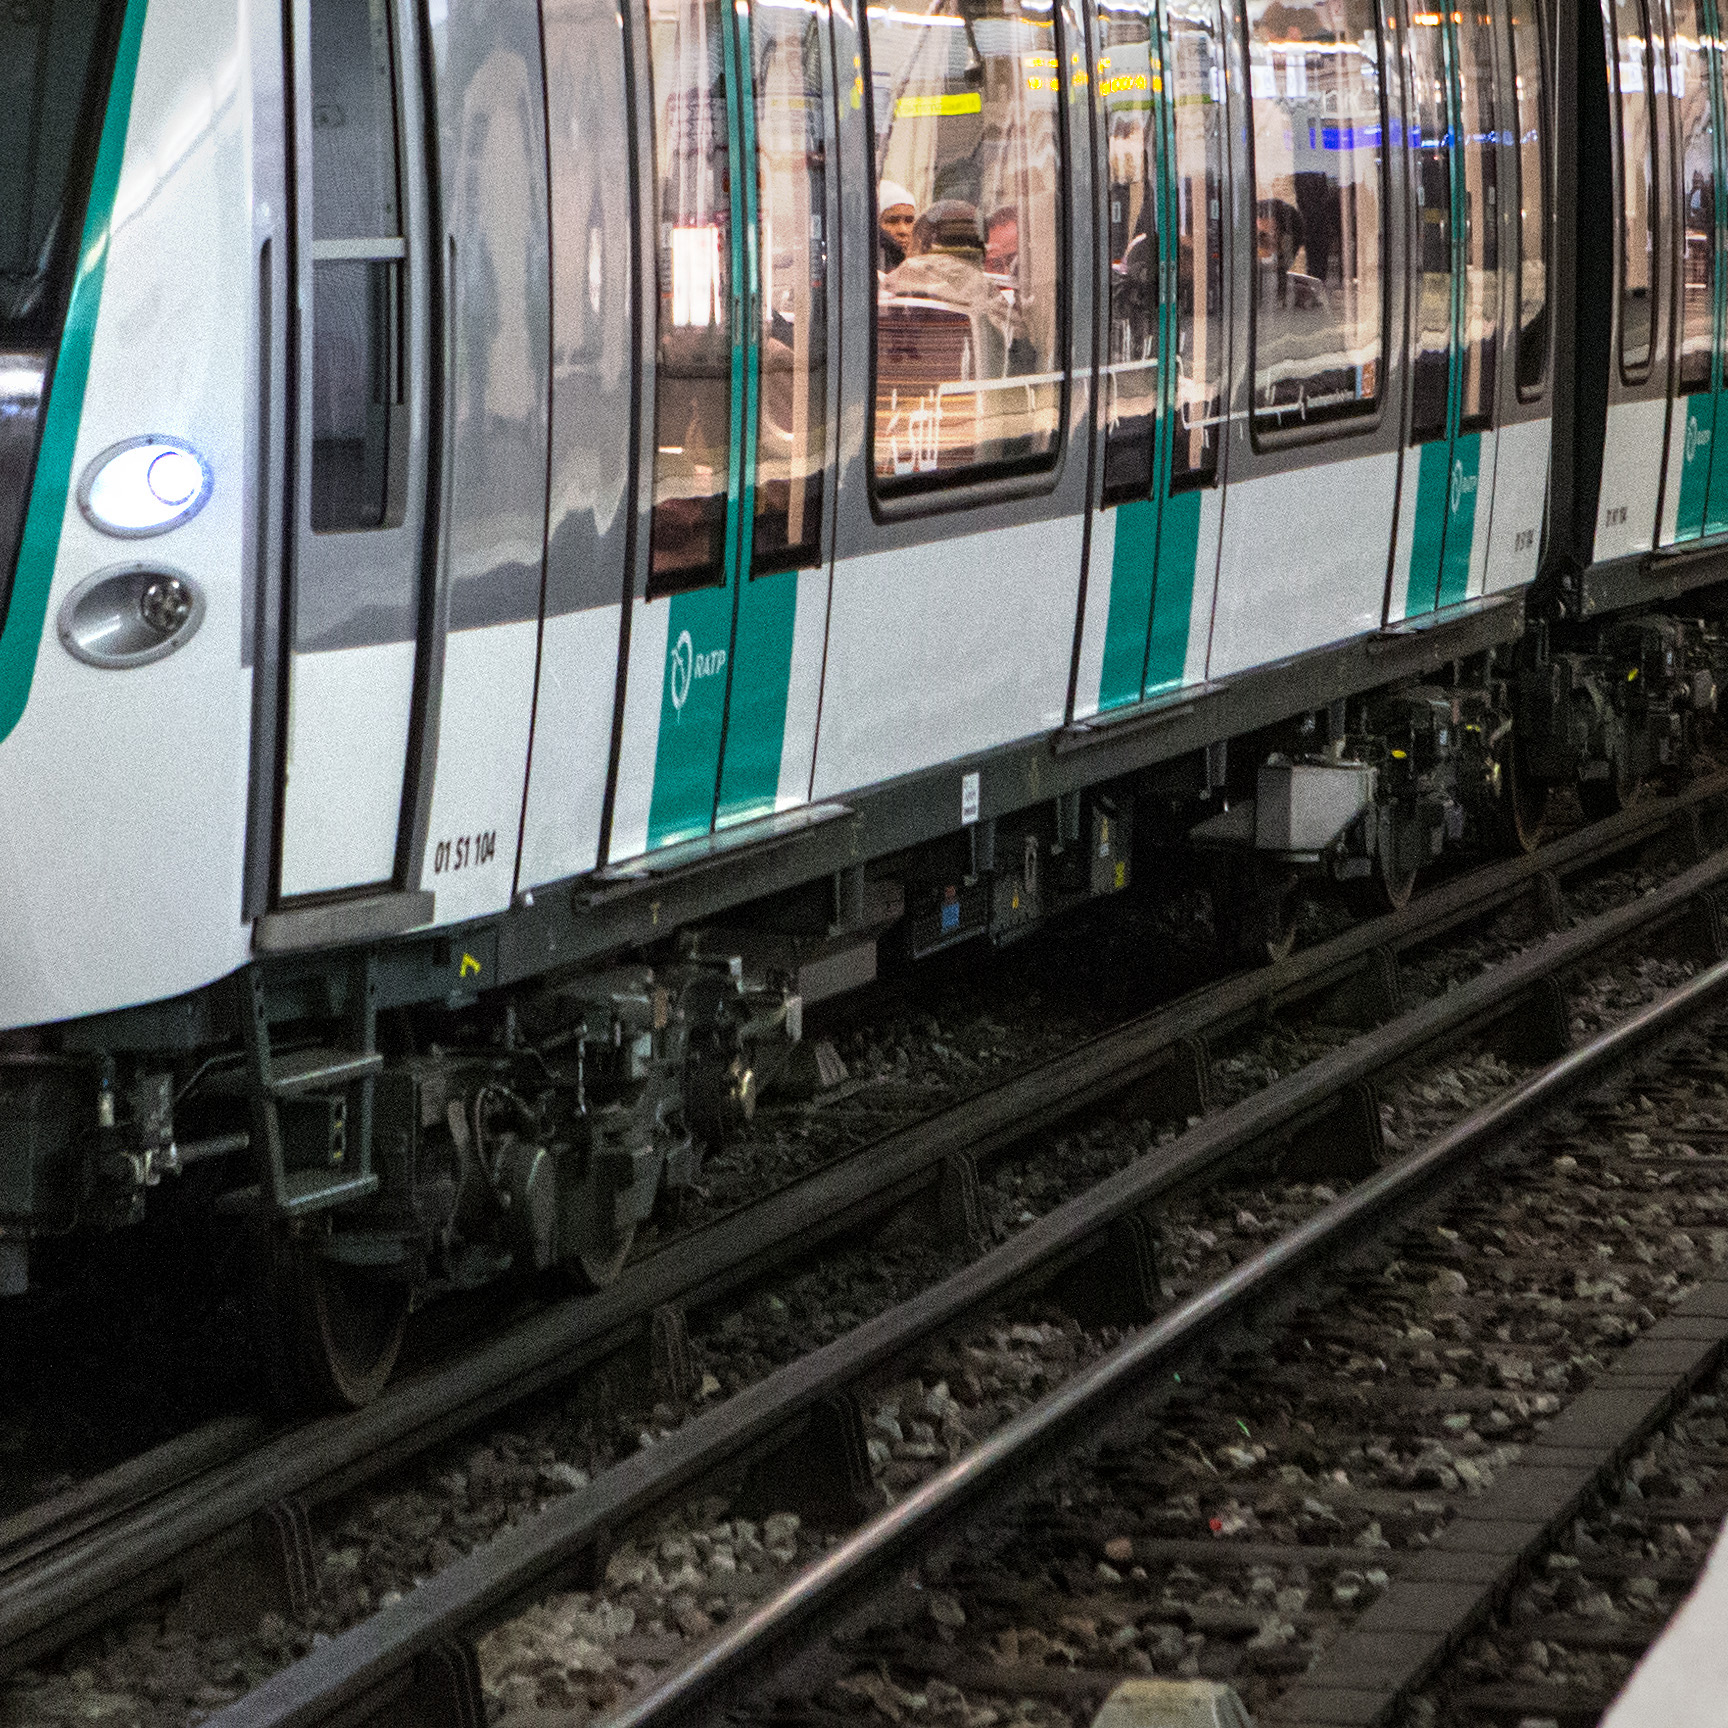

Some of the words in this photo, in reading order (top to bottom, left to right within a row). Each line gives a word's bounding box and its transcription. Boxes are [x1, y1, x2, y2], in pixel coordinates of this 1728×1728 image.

[693, 649, 727, 679] RATP
[434, 840, 452, 874] 01
[474, 829, 497, 866] 104
